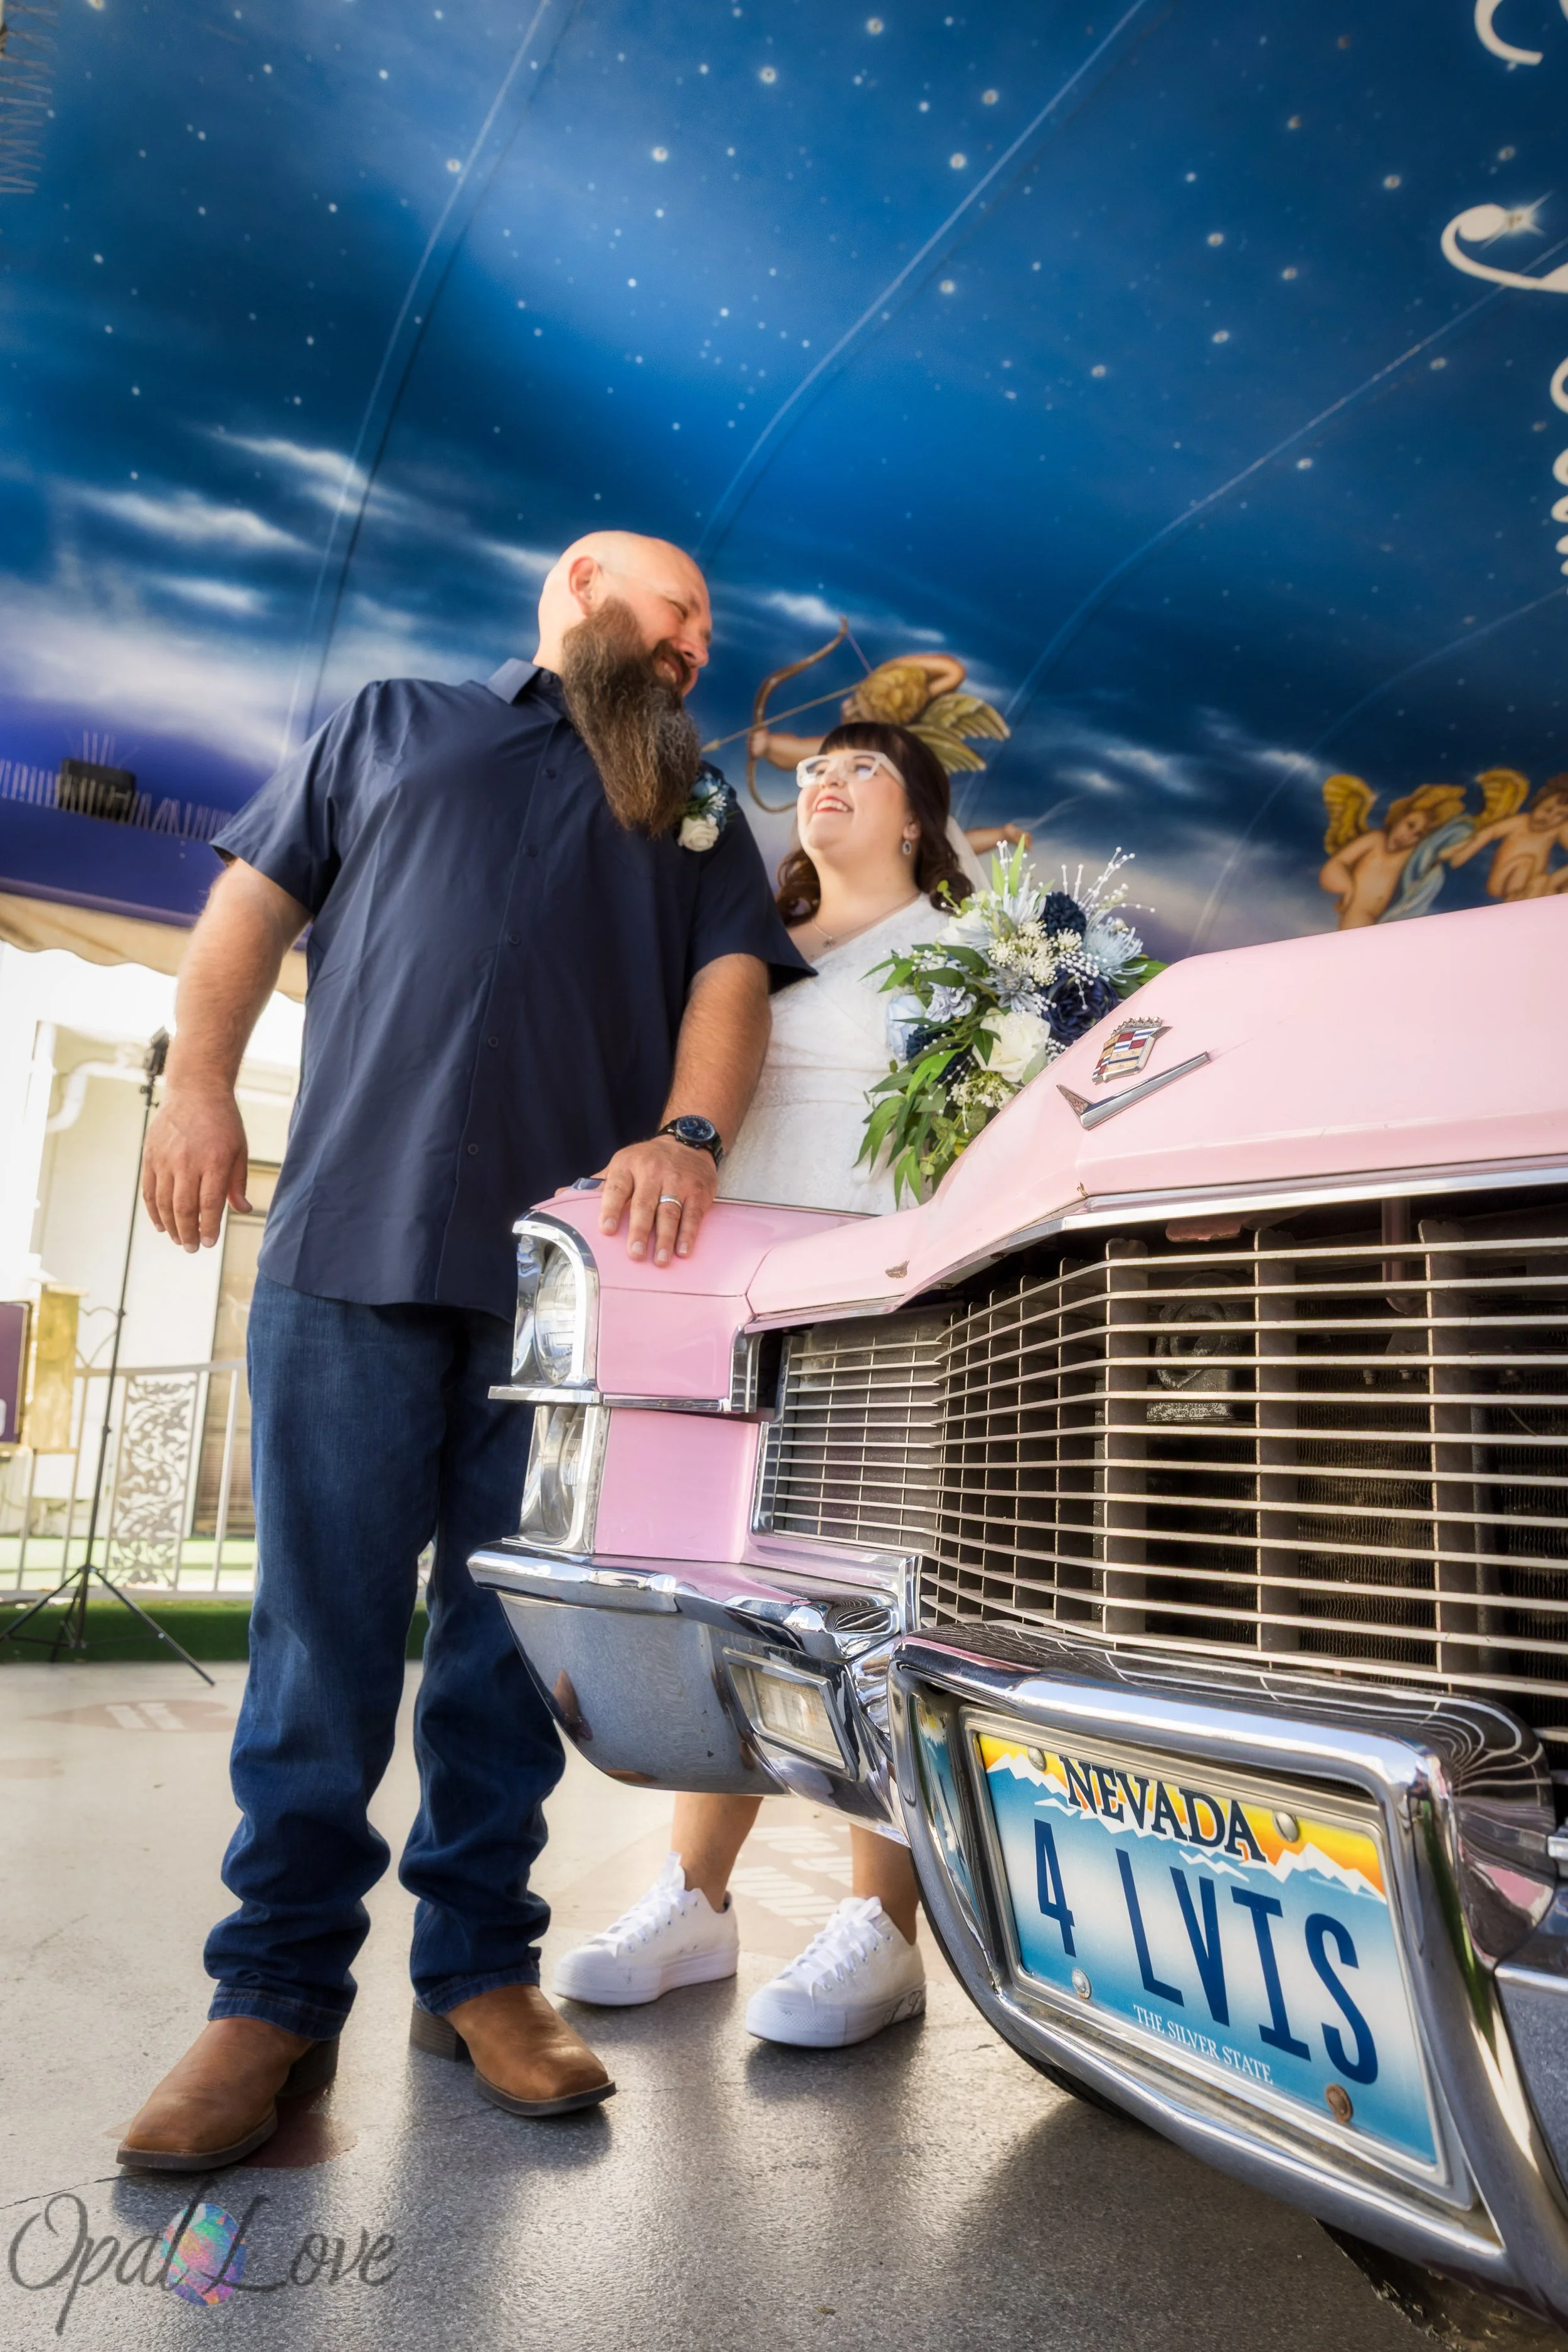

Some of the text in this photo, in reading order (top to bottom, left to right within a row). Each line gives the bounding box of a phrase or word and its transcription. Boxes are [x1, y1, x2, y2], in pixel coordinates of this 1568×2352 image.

[1058, 1755, 1267, 1863] NEVADA
[1033, 1818, 1379, 2085] 4 LVIS
[1133, 2003, 1274, 2085] THE SILVER STATE
